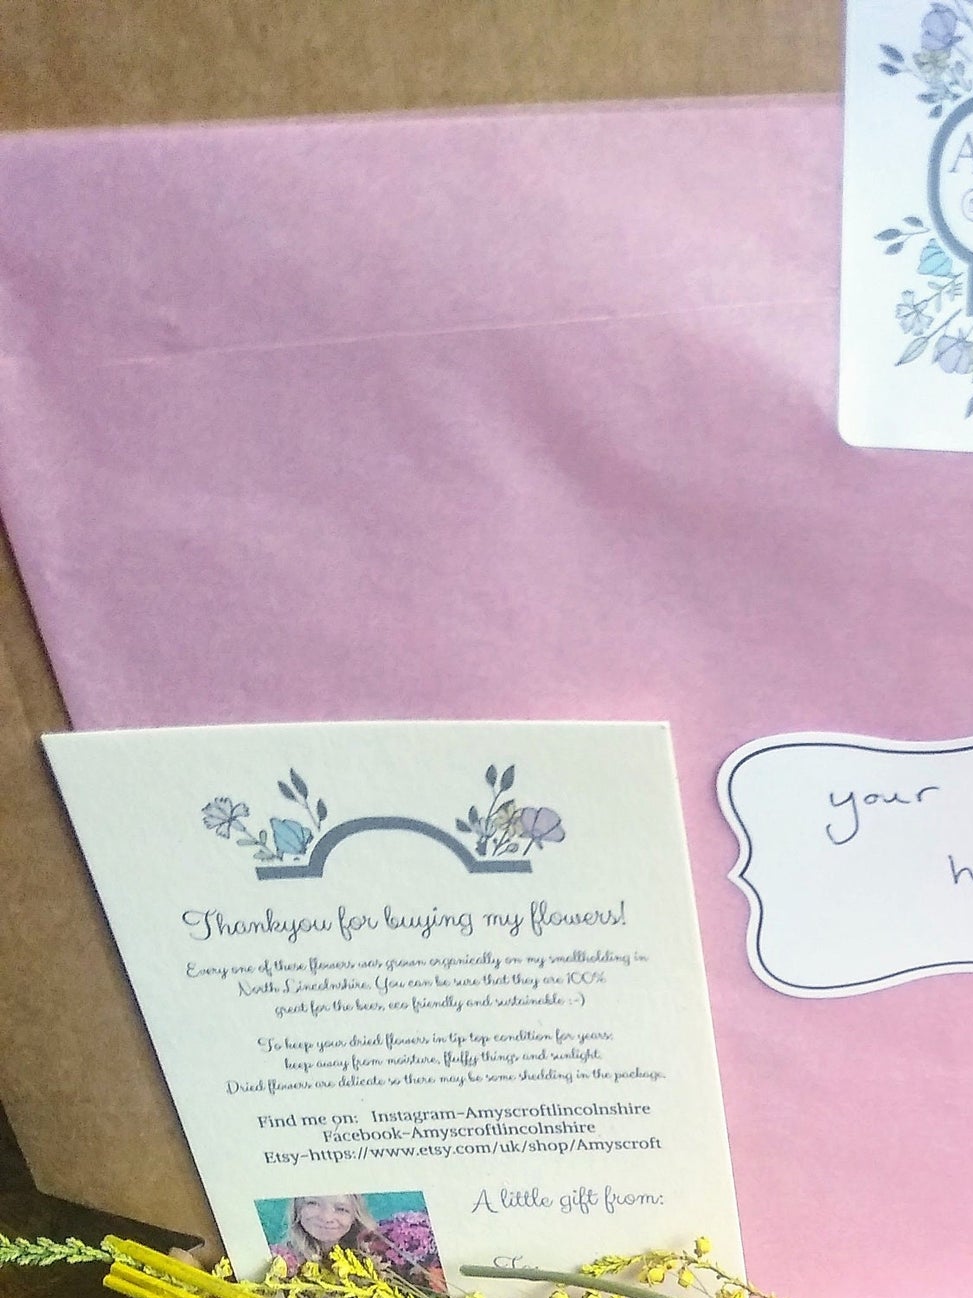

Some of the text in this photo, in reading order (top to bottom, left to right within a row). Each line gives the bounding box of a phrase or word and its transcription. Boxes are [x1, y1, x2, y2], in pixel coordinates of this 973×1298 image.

[826, 785, 941, 846] your
[182, 900, 626, 943] Thankyou for buying my flowers!
[186, 961, 227, 979] Every
[231, 965, 254, 974] one
[258, 960, 273, 976] of
[273, 960, 307, 973] these
[309, 957, 355, 975] flowers
[358, 959, 382, 969] was
[430, 951, 501, 969] organically
[505, 957, 522, 965] on
[527, 956, 545, 968] my
[549, 950, 631, 966] smallholding
[633, 950, 648, 962] in
[238, 979, 279, 997] North
[375, 975, 404, 994] You
[408, 979, 433, 987] can
[435, 975, 450, 986] be
[453, 978, 481, 987] sure
[482, 973, 510, 986] that
[512, 973, 539, 989] they
[567, 971, 606, 984] 100%
[275, 1003, 307, 1018] great
[310, 1000, 330, 1018] for
[332, 1000, 354, 1011] the
[388, 1002, 408, 1010] eco
[412, 995, 463, 1013] friendly
[466, 994, 492, 1007] and
[495, 993, 565, 1007] sustainable
[257, 1036, 282, 1052] To
[284, 1037, 314, 1054] keep
[316, 1039, 347, 1053] your
[349, 1033, 383, 1047] dried
[385, 1032, 429, 1050] flowers
[433, 1033, 446, 1043] in
[449, 1033, 466, 1047] tip
[469, 1032, 491, 1047] top
[493, 1030, 553, 1042] condition
[554, 1028, 575, 1044] for
[284, 1058, 314, 1072] keep
[316, 1061, 349, 1071] away
[351, 1054, 382, 1071] from
[443, 1050, 479, 1067] fluffy
[481, 1050, 519, 1064] things
[522, 1049, 548, 1061] and
[226, 1079, 265, 1095] Dried
[268, 1079, 312, 1095] flowers
[315, 1081, 335, 1089] are
[338, 1076, 386, 1088] delicate
[388, 1078, 401, 1086] so
[404, 1074, 436, 1085] there
[439, 1076, 466, 1087] may
[468, 1072, 483, 1082] be
[485, 1074, 516, 1083] some
[519, 1069, 573, 1083] shedding
[576, 1069, 590, 1079] in
[592, 1068, 611, 1079] the
[257, 1102, 651, 1128] Find me on: Instagram-Amyscroftlincolnshire
[323, 1121, 596, 1142] Facebook-Amyscroftlincolnshire
[472, 1185, 664, 1214] A little gift from:
